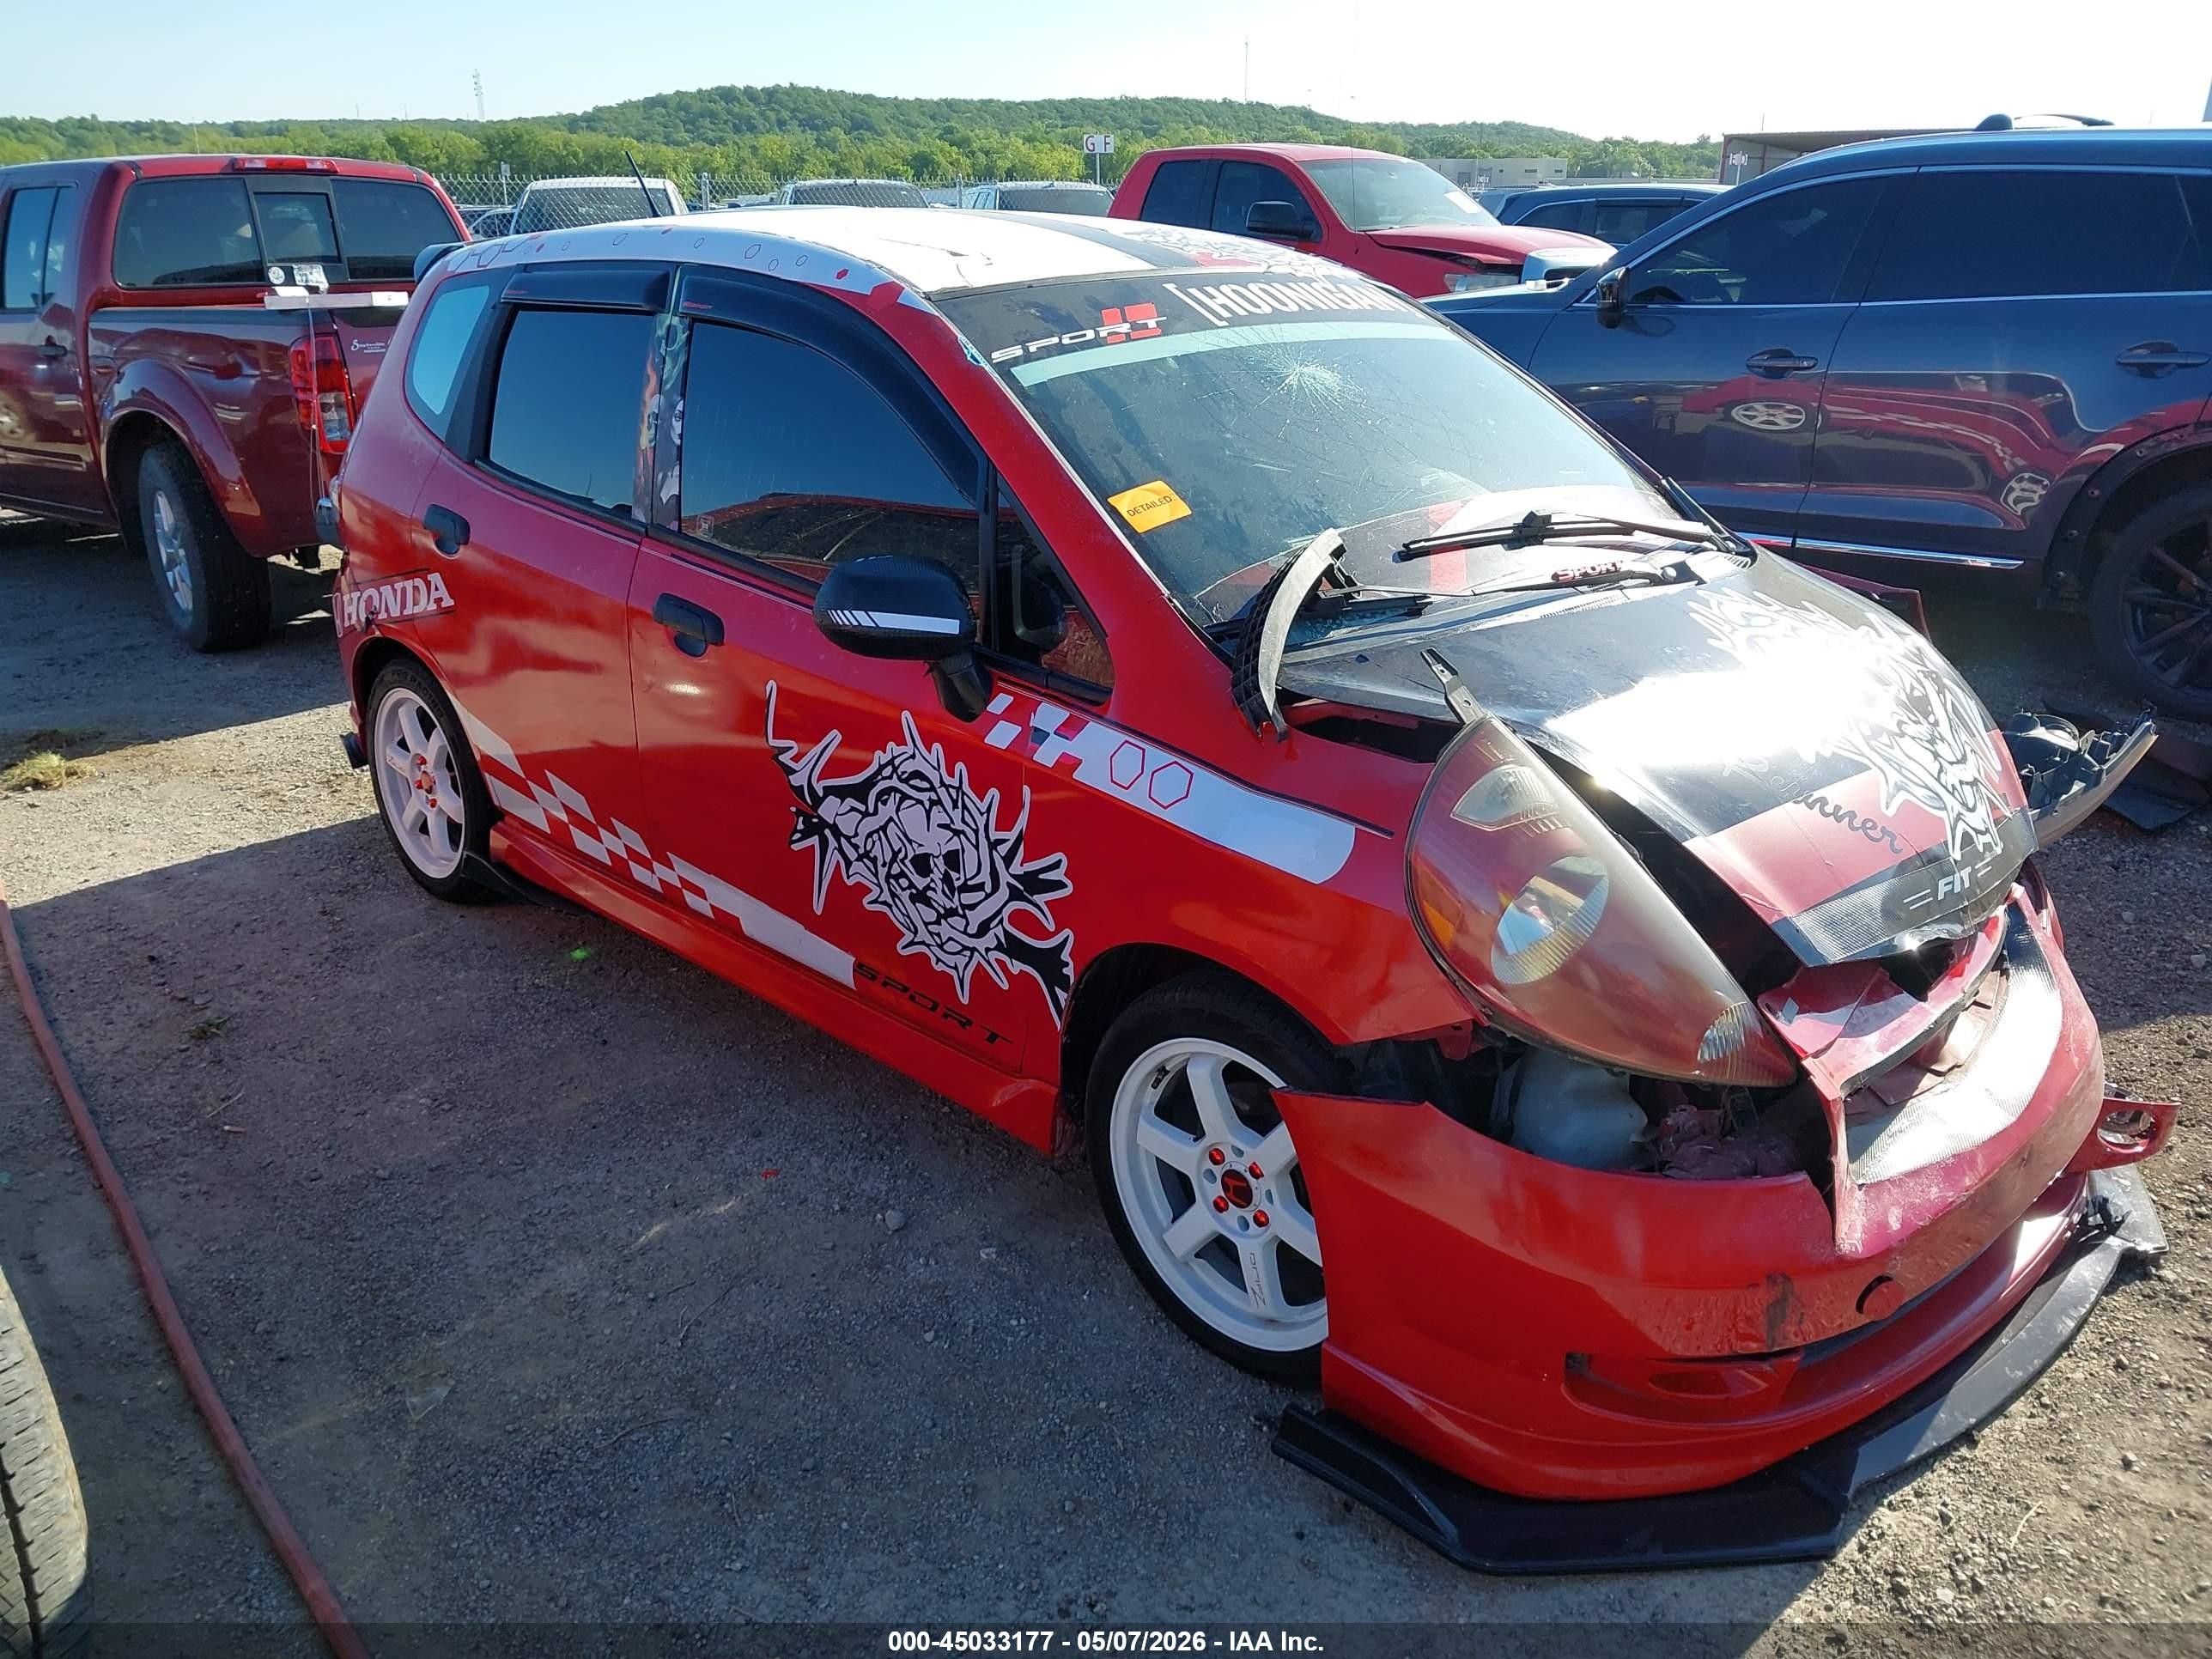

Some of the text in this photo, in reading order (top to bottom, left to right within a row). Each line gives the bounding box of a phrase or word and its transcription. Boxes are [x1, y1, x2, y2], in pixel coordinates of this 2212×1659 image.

[1085, 135, 1111, 152] G F
[991, 316, 1168, 363] SPORT
[1126, 495, 1173, 517] DETAILED
[1551, 560, 1623, 582] SPORT
[343, 572, 455, 629] HONDA
[1937, 866, 1972, 901] FIT
[854, 961, 1013, 1045] SPORT
